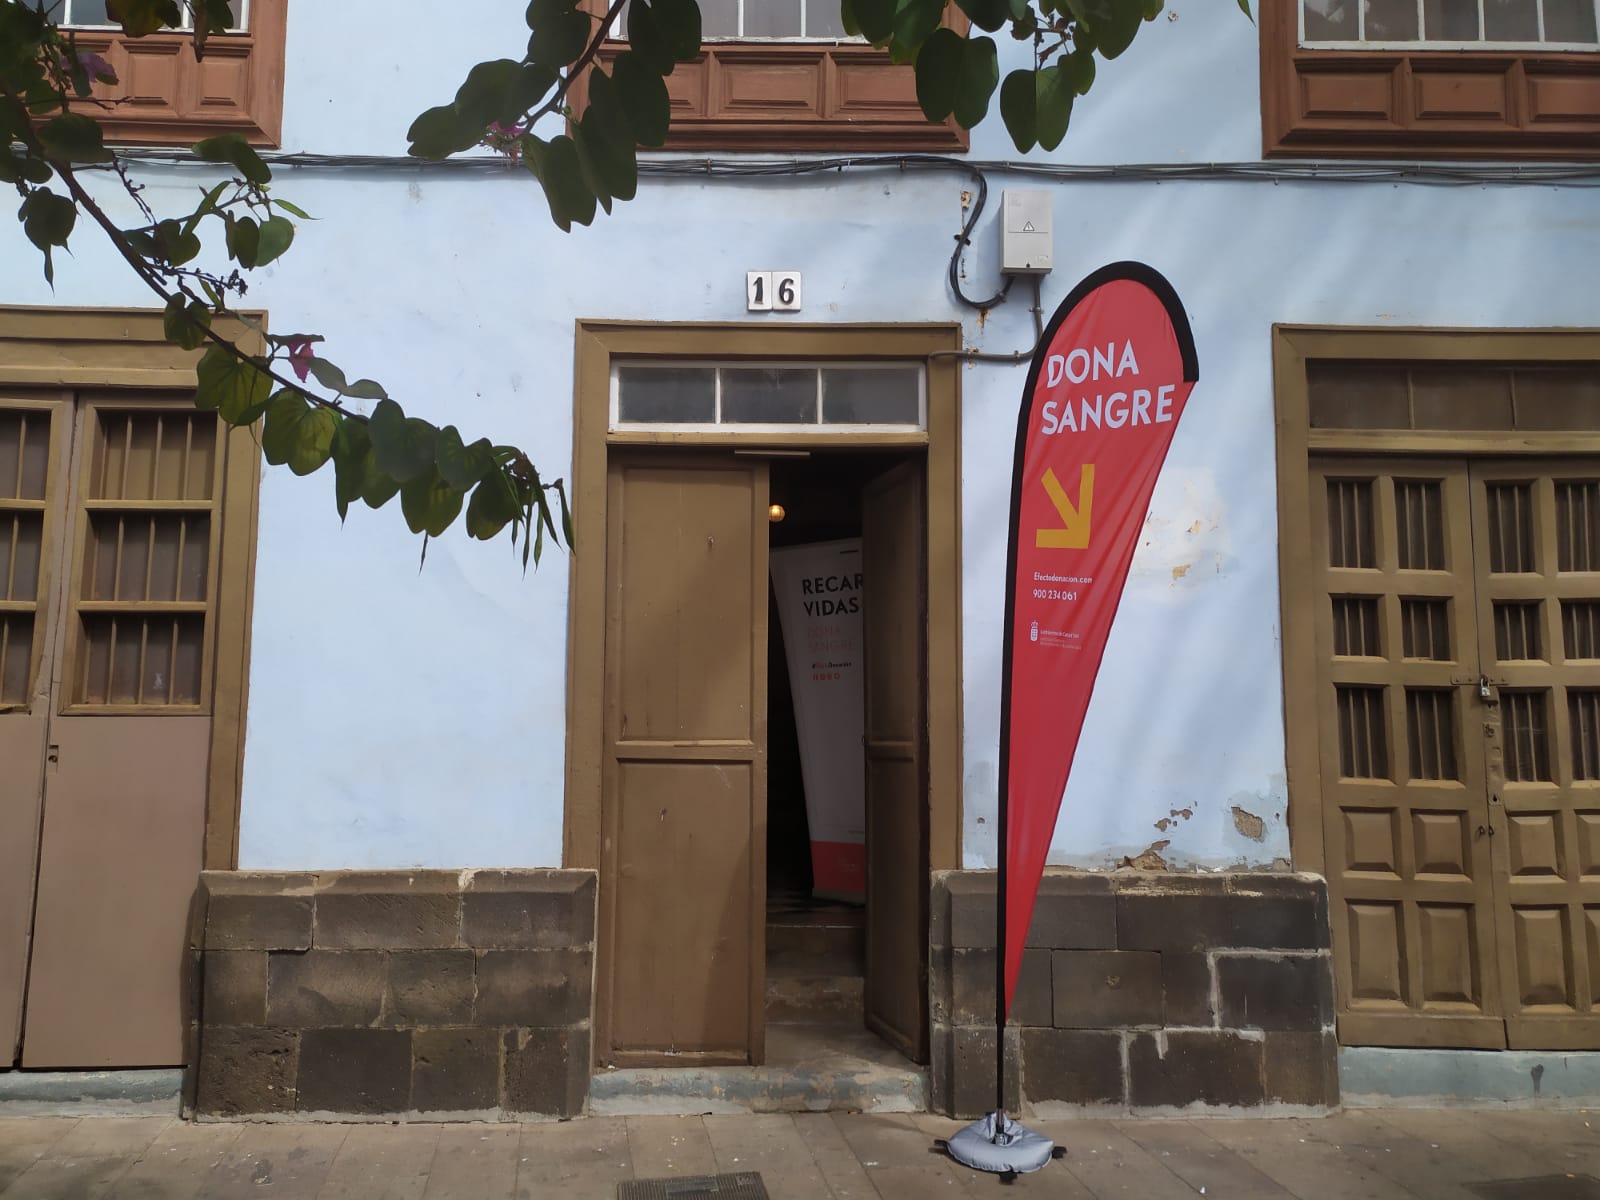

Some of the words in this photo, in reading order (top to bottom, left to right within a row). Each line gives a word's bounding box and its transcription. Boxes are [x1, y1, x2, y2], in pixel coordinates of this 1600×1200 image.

[752, 276, 795, 305] 16
[1047, 339, 1139, 389] DONA
[1041, 384, 1175, 435] SANGRE
[803, 597, 859, 617] VIDAS
[1033, 588, 1047, 599] 900
[1048, 590, 1061, 600] 234
[1062, 591, 1077, 601] 061
